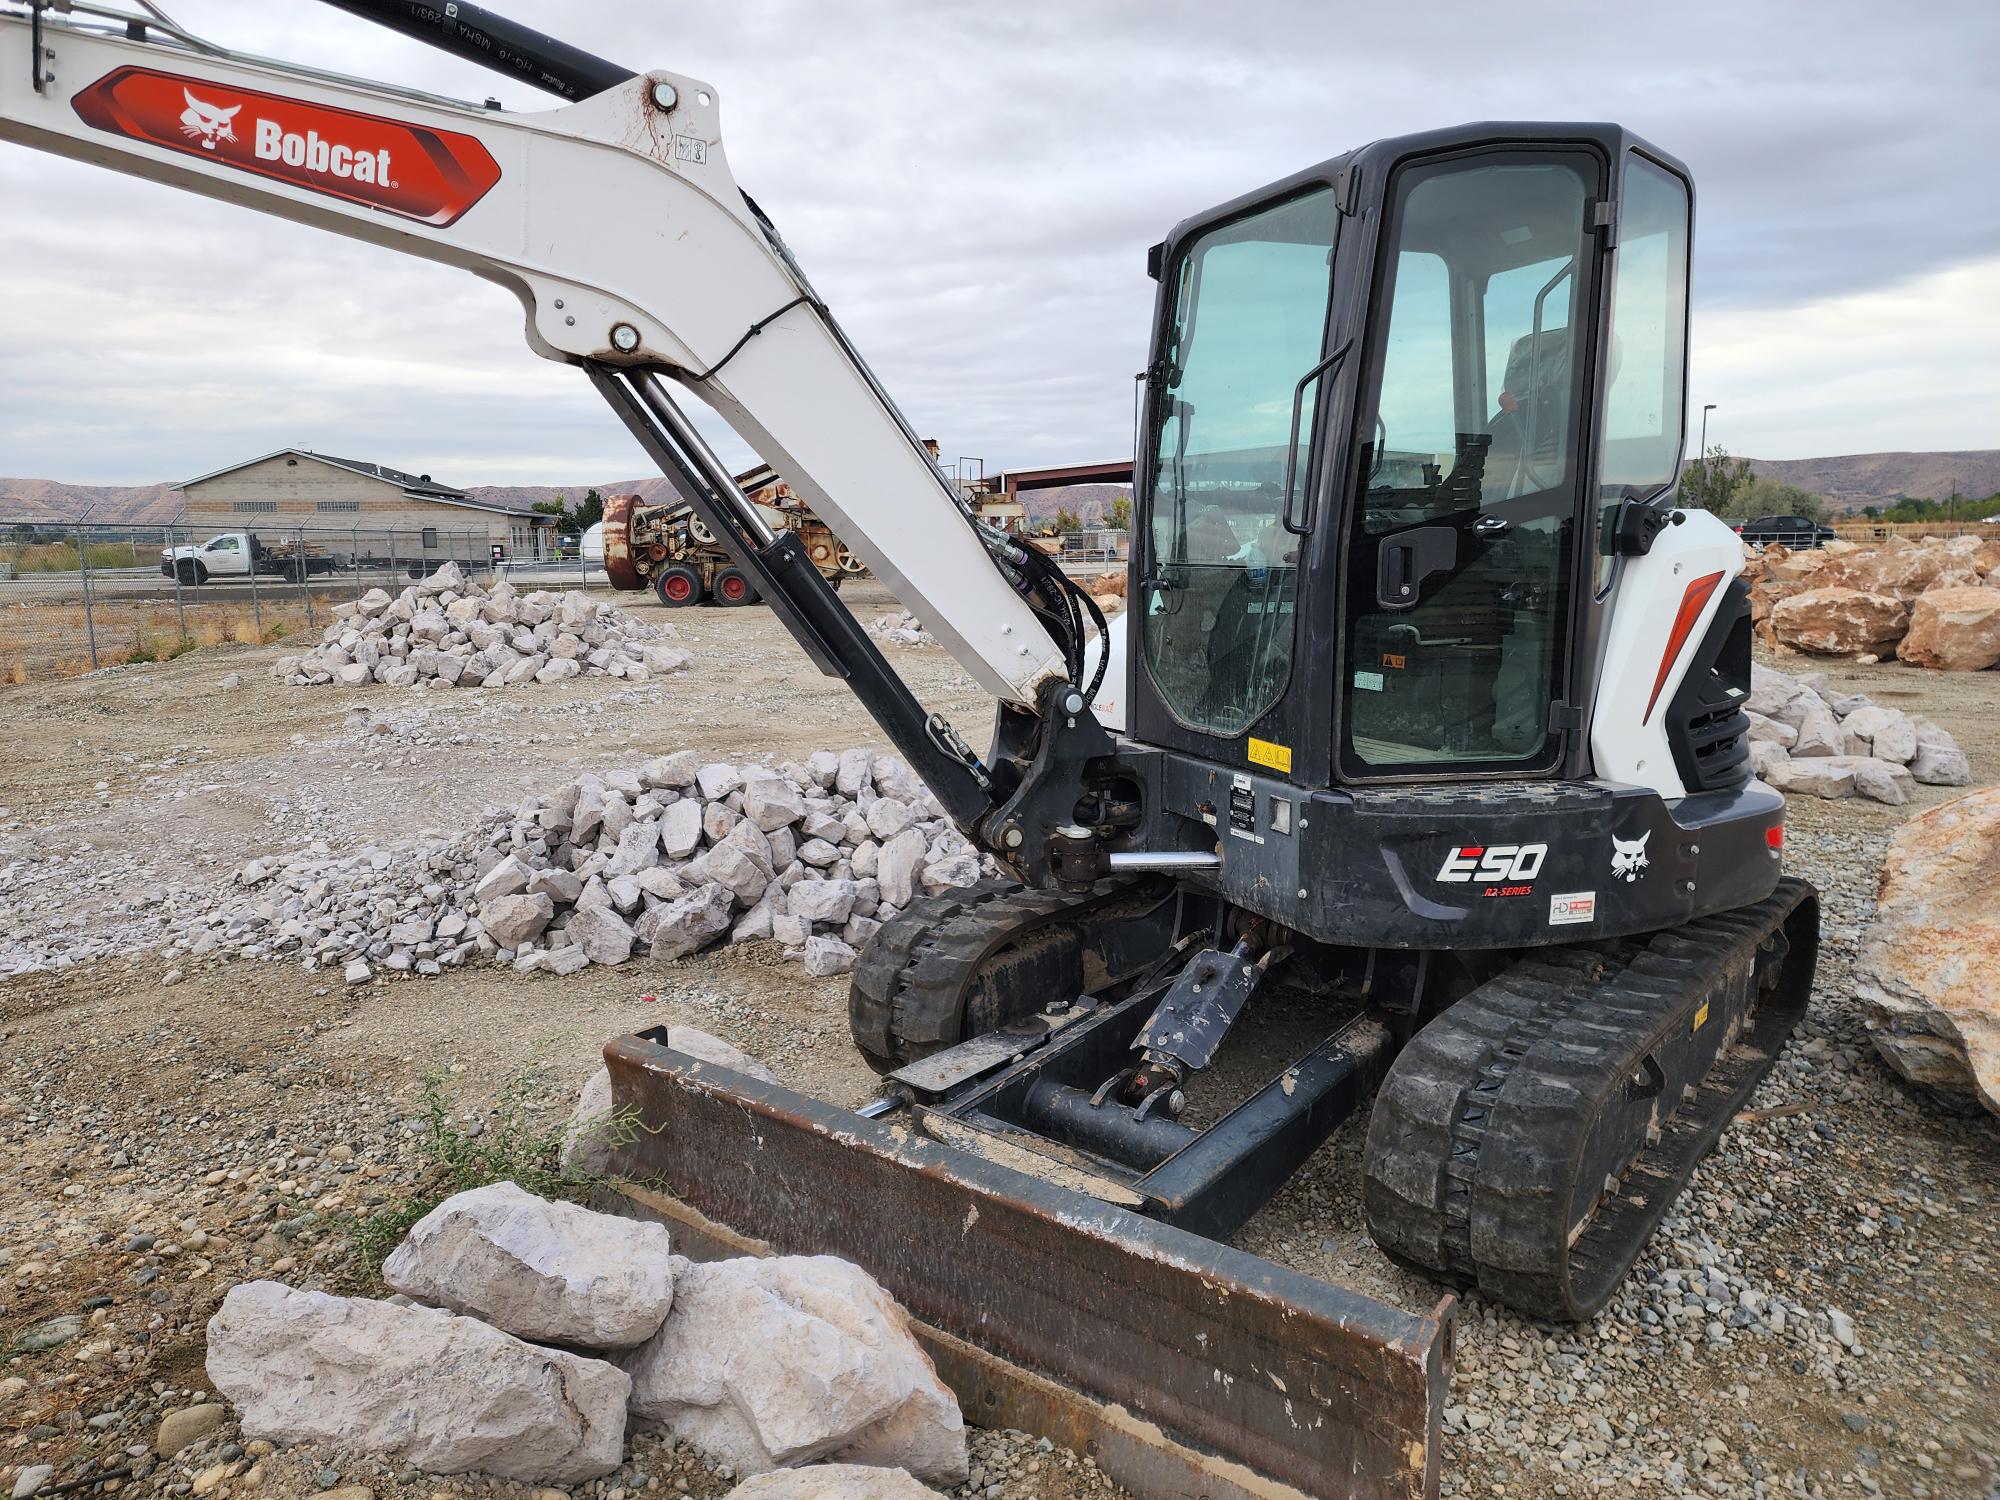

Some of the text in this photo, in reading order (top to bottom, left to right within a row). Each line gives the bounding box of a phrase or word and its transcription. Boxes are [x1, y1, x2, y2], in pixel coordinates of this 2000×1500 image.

[410, 5, 457, 30] I-293/1
[459, 26, 491, 50] MSHA
[254, 118, 391, 188] Bobcat
[1435, 843, 1548, 882] E50
[1484, 886, 1533, 897] R2-SERIES
